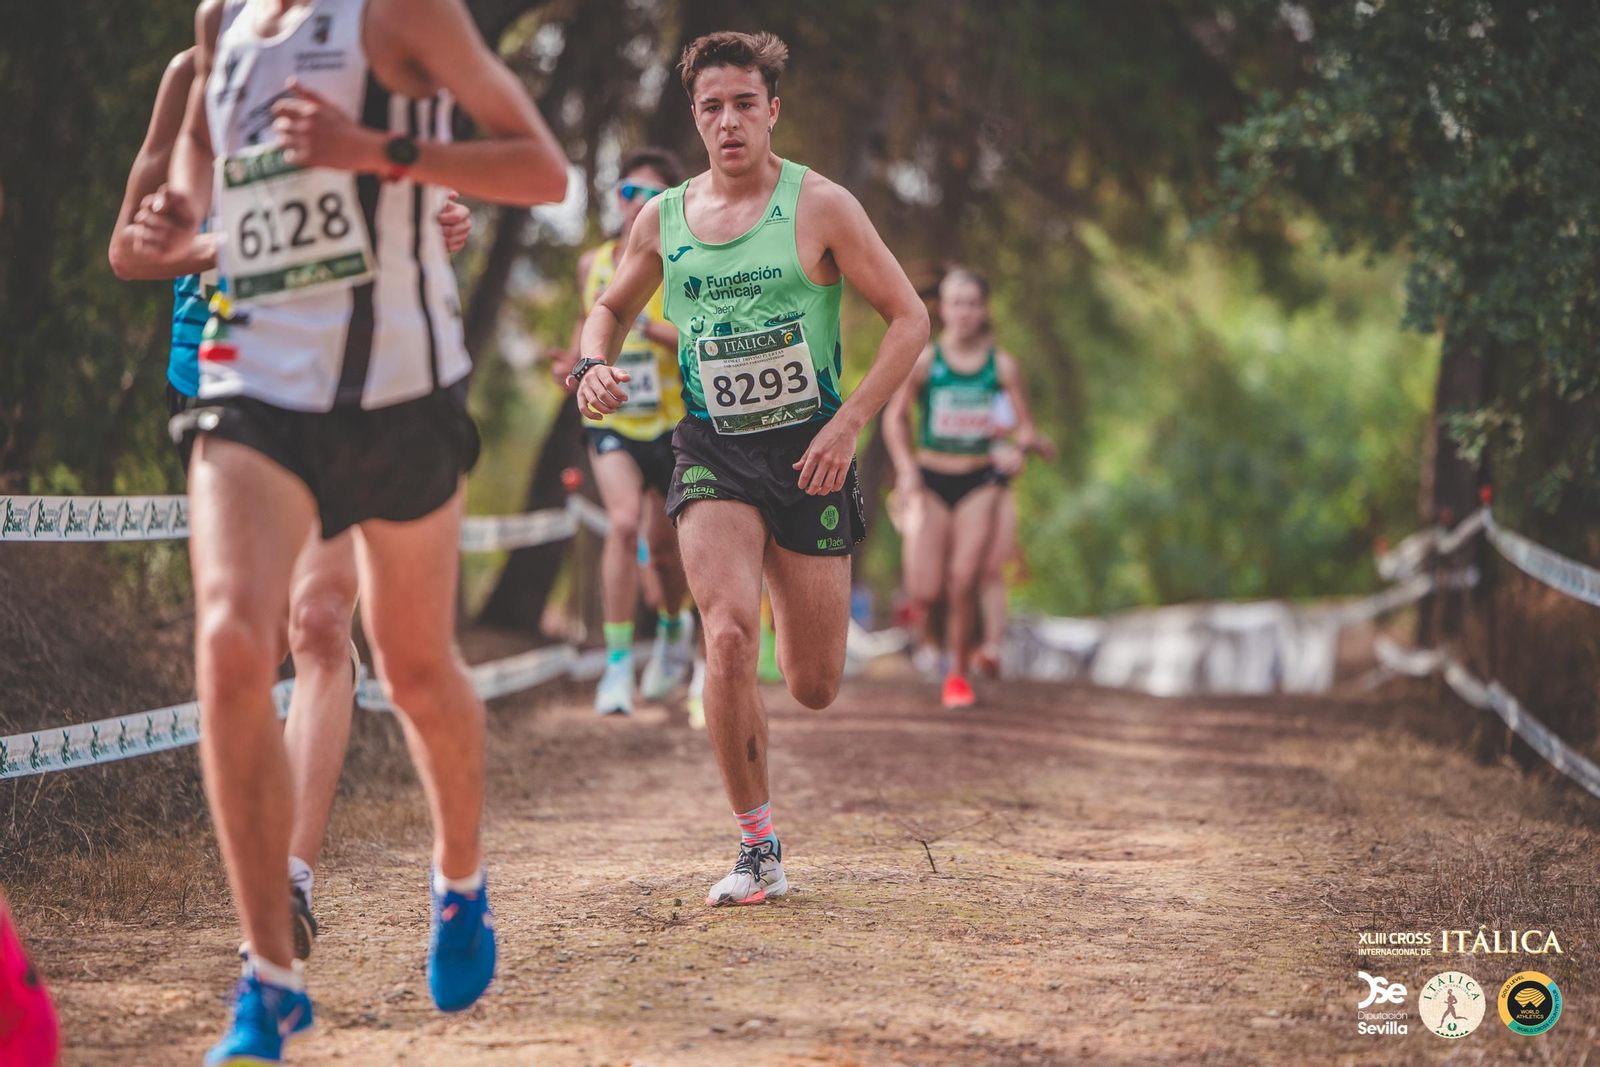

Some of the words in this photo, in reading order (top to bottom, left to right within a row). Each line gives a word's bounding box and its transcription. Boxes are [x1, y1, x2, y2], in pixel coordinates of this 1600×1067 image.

[239, 193, 350, 259] 6128
[706, 266, 782, 289] Fundación
[709, 283, 762, 300] Unicaja
[713, 304, 735, 315] Jaén
[724, 335, 776, 352] ITÁLICA
[713, 361, 808, 407] 8293
[682, 484, 715, 496] Unicaja
